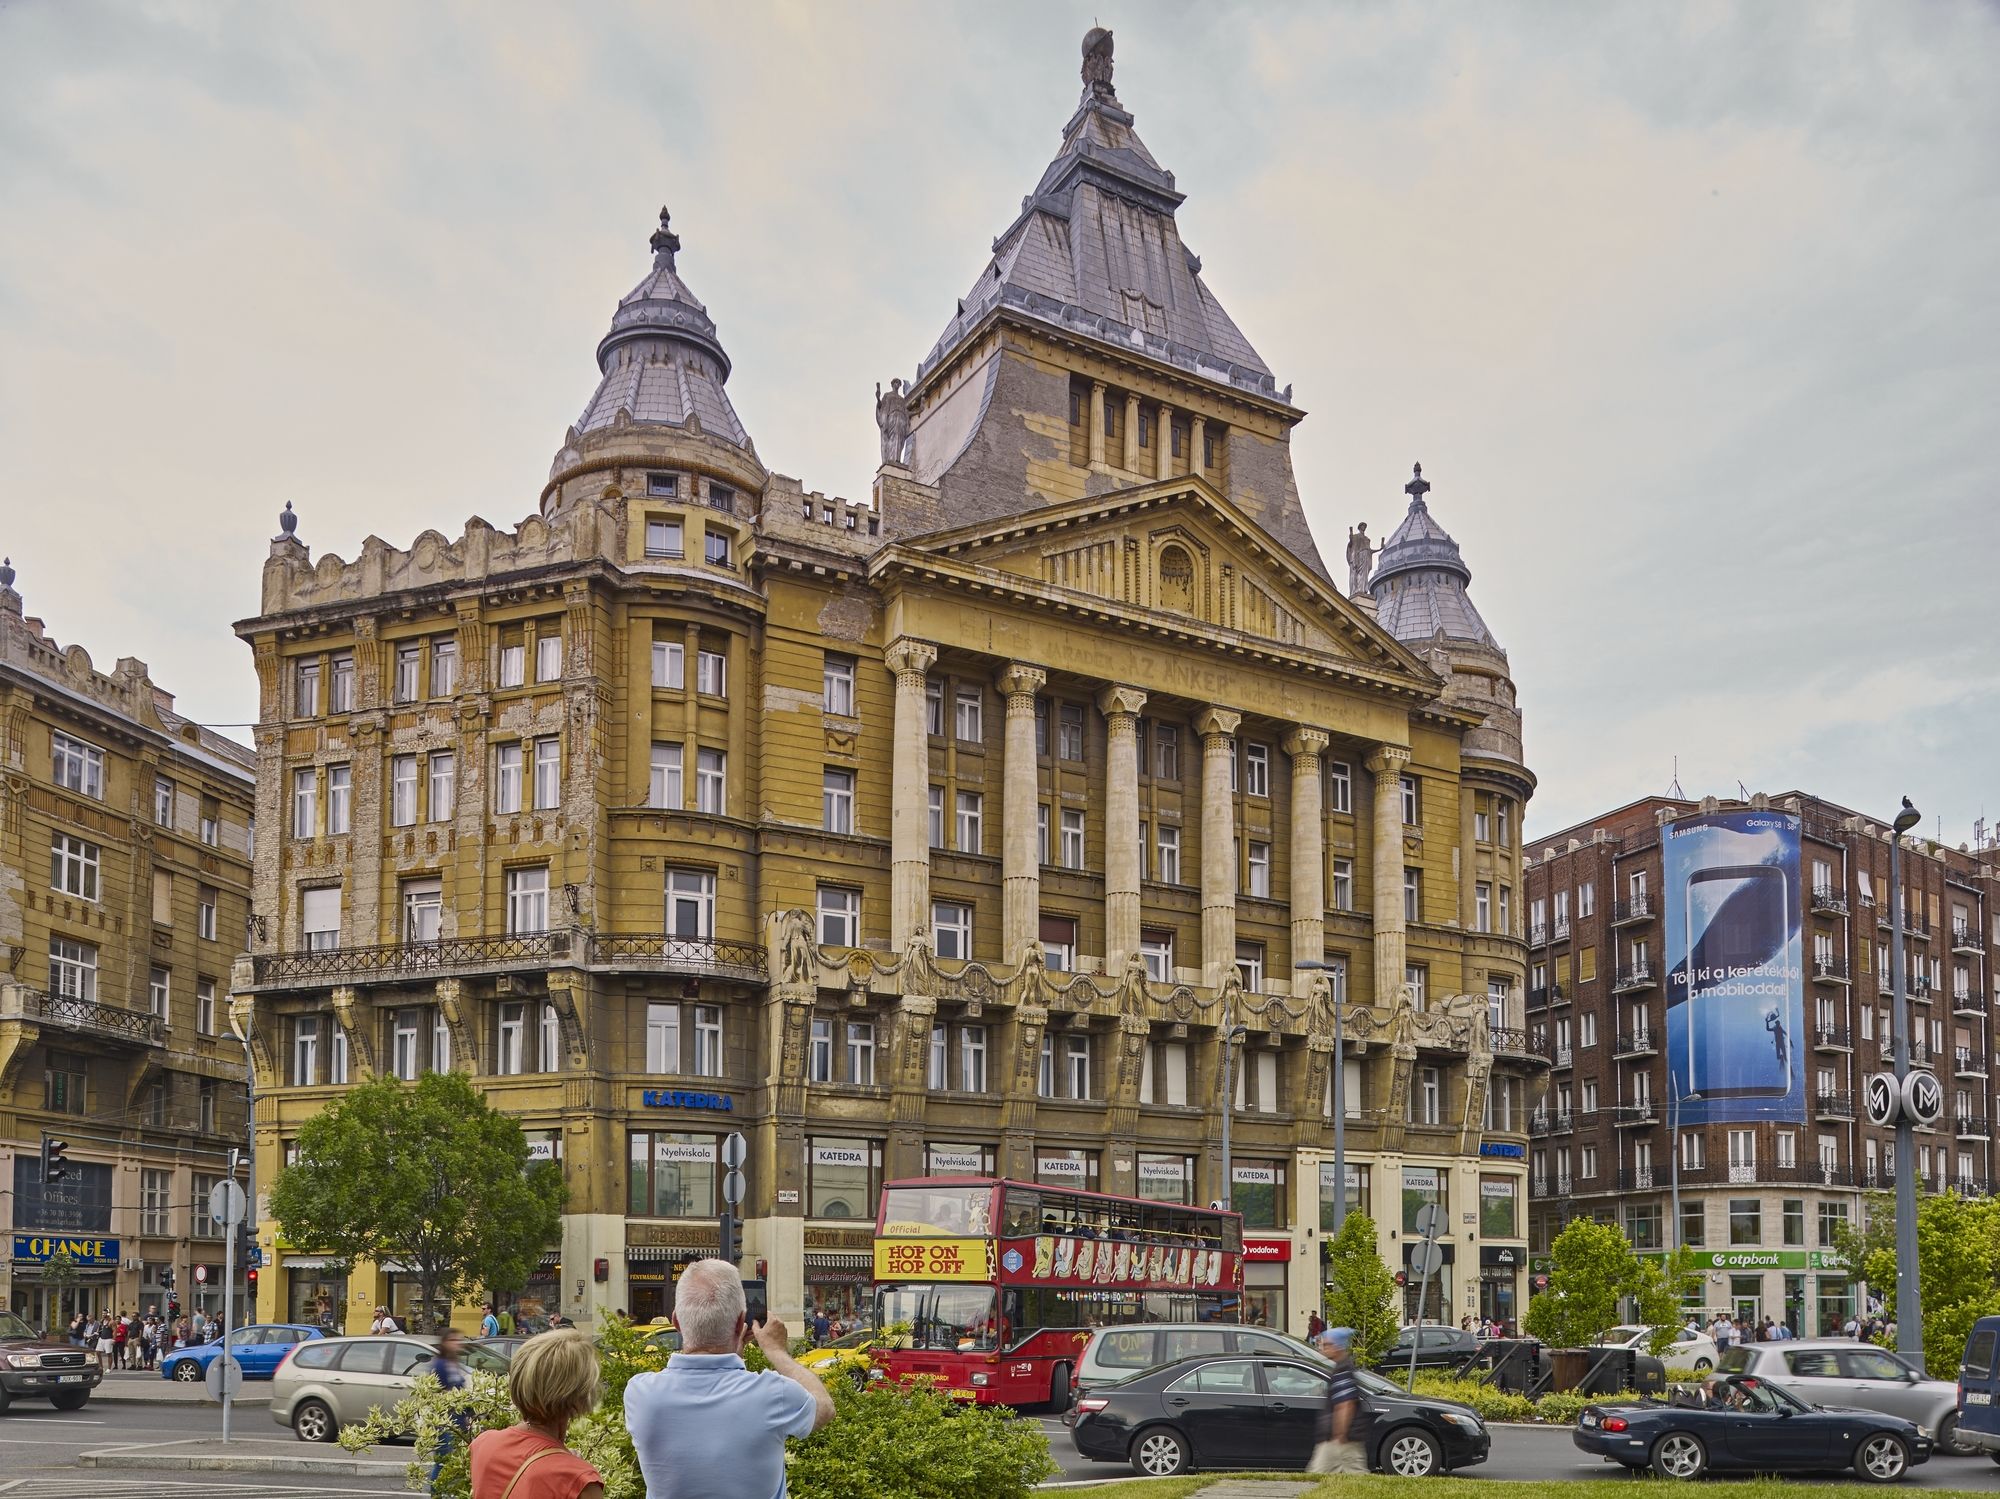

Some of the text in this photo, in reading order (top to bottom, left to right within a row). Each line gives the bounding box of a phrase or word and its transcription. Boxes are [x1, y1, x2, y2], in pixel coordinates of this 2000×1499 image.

[1746, 819, 1774, 829] Galaxy
[1669, 824, 1708, 839] SAMSUNG
[1672, 970, 1695, 985] Törj
[1698, 966, 1709, 981] ki
[1713, 968, 1724, 980] a
[1690, 989, 1698, 1000] a
[643, 1090, 734, 1111] KATEDRA
[661, 1147, 711, 1158] Nyelviskola
[819, 1151, 862, 1161] KATEDRA
[935, 1156, 977, 1167] Nyelviskola
[1044, 1161, 1080, 1171] KATEDRA
[1143, 1166, 1180, 1176] Nyelviskola
[1237, 1171, 1270, 1180] KATEDRA
[1406, 1178, 1433, 1187] KATEDRA
[1483, 1185, 1510, 1194] Nyelviskola
[43, 1190, 78, 1206] Offices
[890, 1225, 921, 1234] Official
[29, 1238, 106, 1257] CHANGE
[888, 1245, 960, 1260] HOP ON
[1249, 1245, 1279, 1255] vodafone
[1729, 1254, 1779, 1268] otpbank
[887, 1260, 965, 1274] HOP OFF
